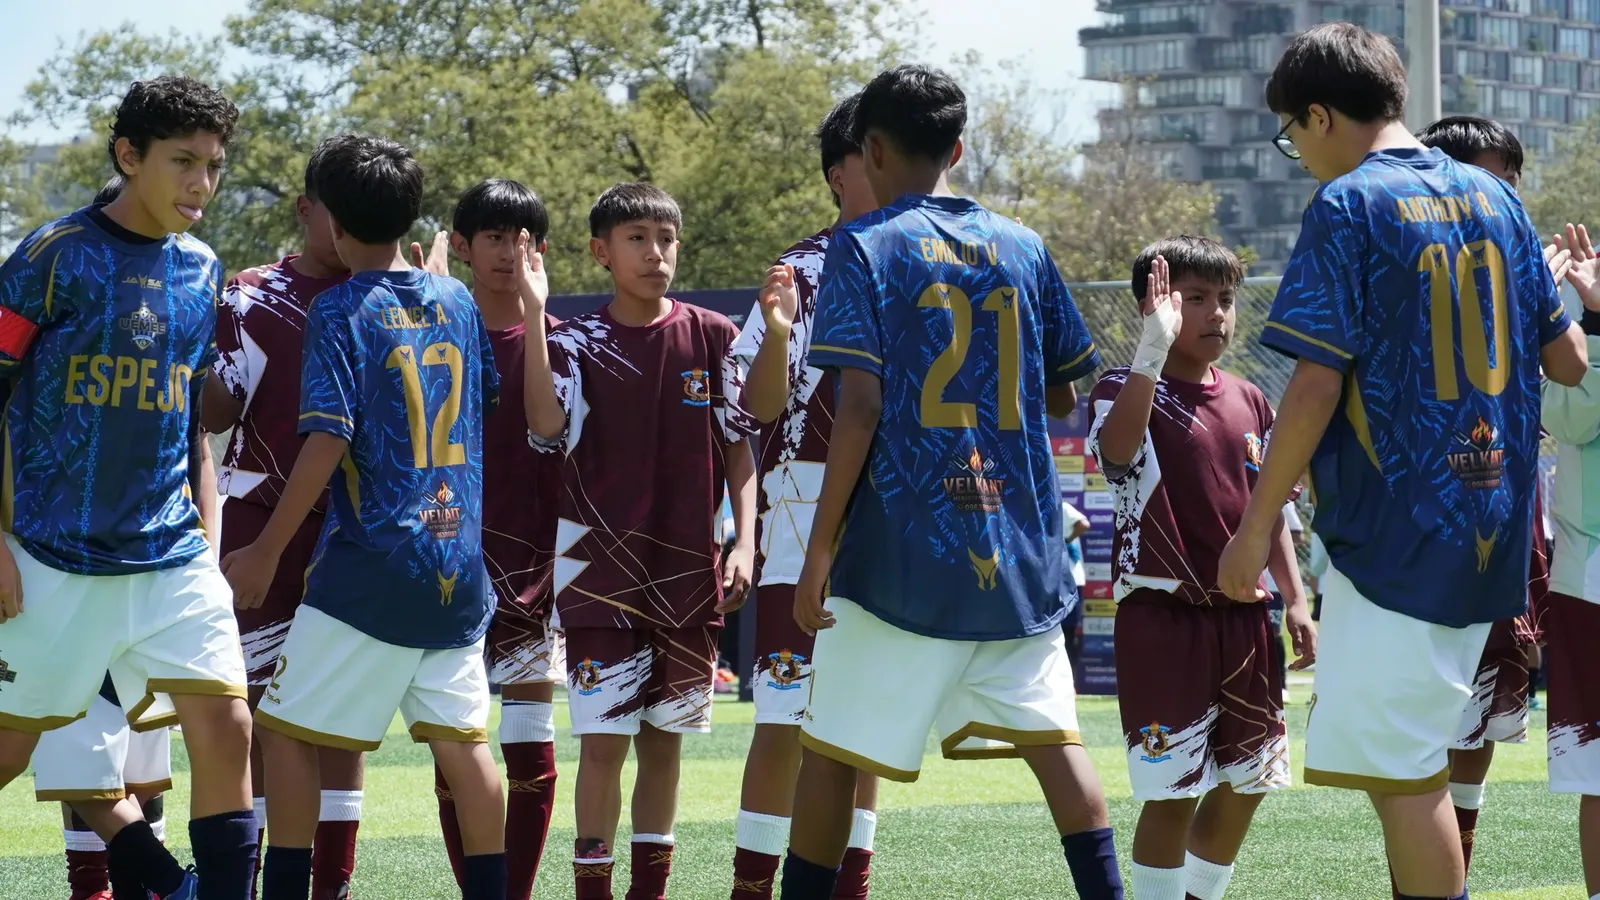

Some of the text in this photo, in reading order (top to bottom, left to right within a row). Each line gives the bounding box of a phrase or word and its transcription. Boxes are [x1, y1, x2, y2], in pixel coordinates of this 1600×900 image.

[919, 237, 978, 266] EMILIO
[64, 354, 193, 413] ESPEJO
[917, 282, 1022, 431] 21
[1417, 239, 1512, 401] 10
[385, 341, 466, 469] 12
